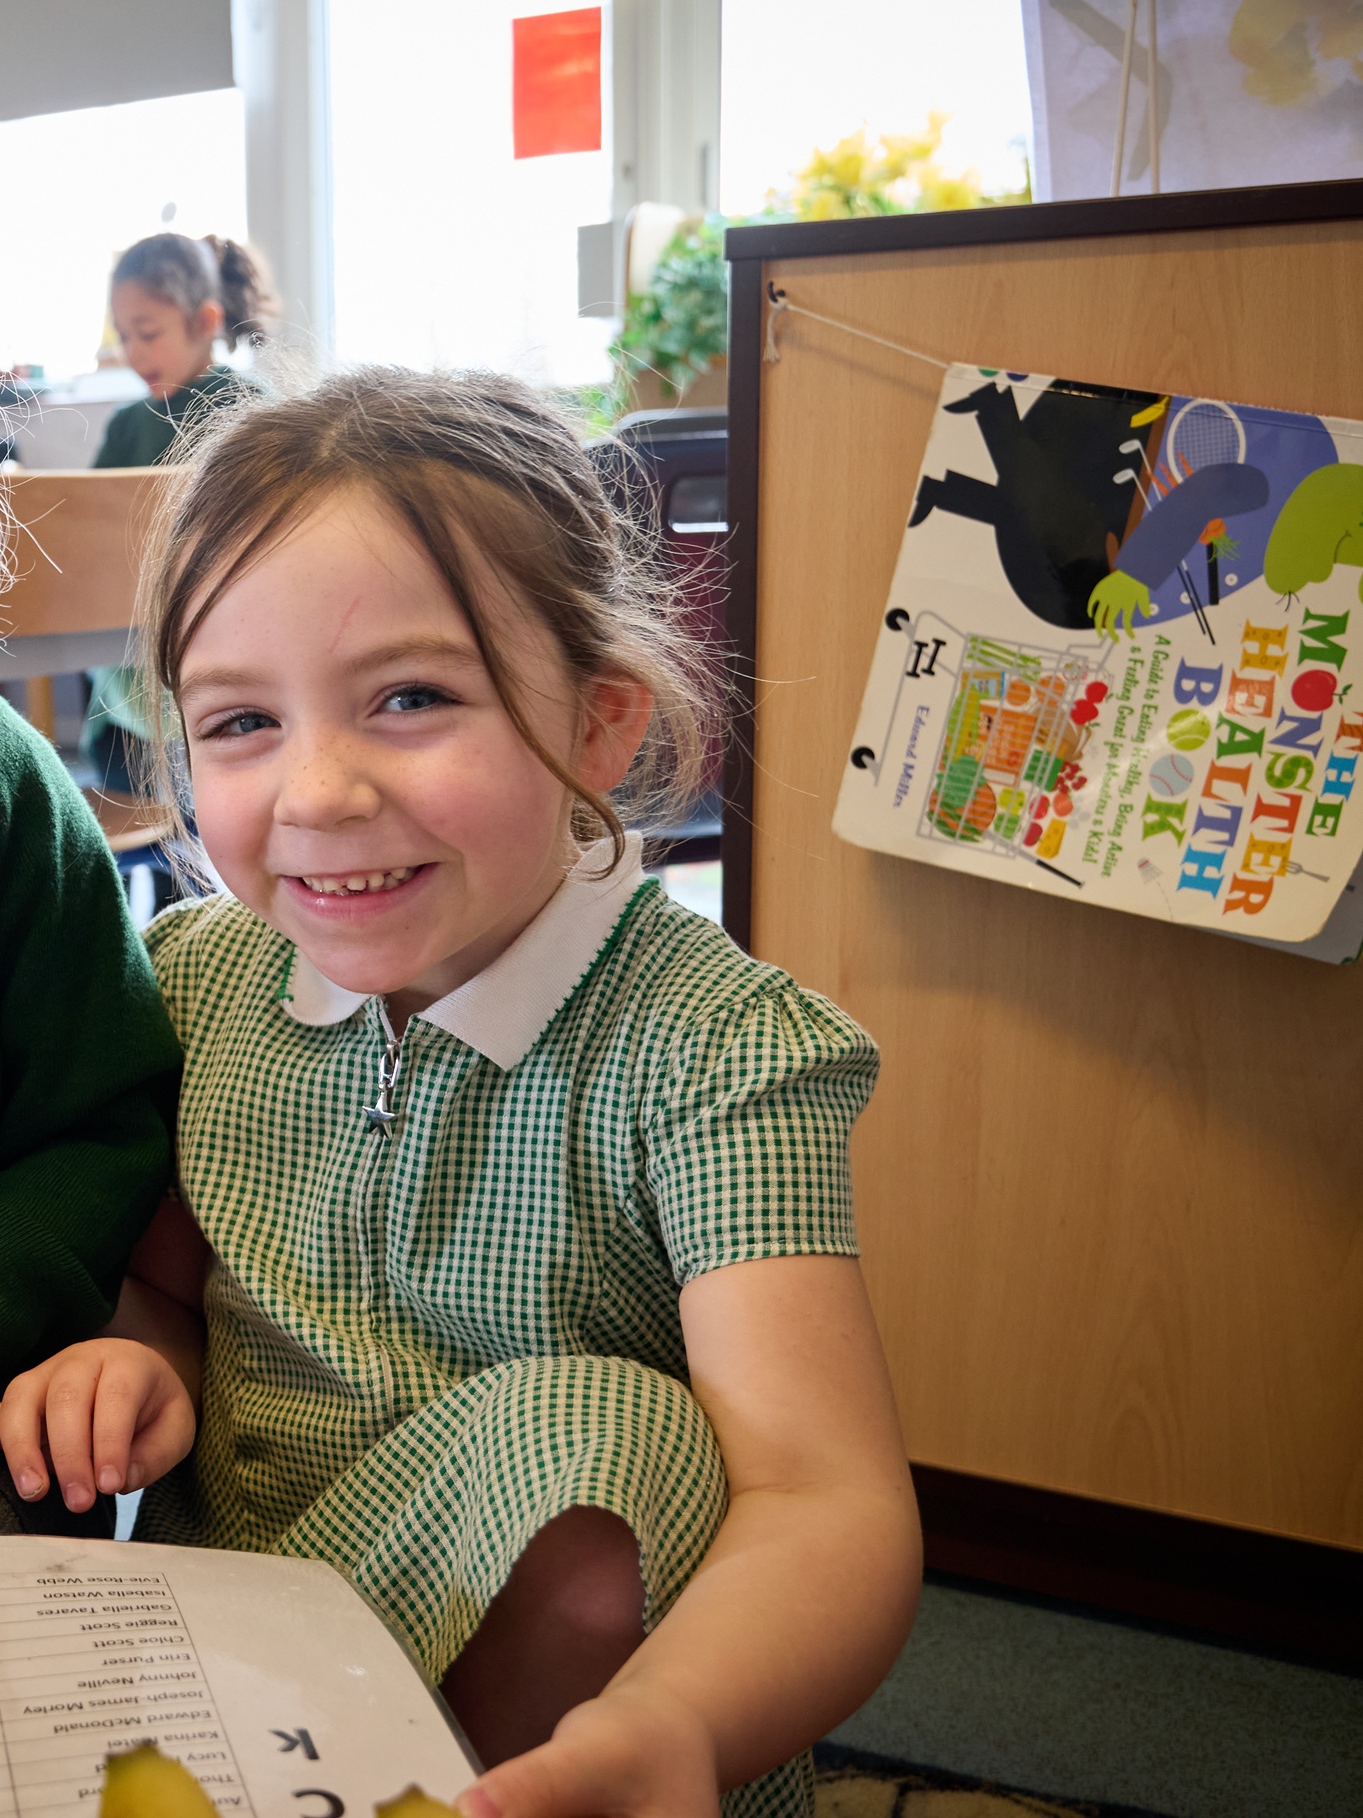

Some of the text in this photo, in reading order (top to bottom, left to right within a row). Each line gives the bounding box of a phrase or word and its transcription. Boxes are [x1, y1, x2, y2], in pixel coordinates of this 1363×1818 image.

[1155, 634, 1171, 646] A
[1147, 649, 1170, 687] Guide
[1116, 657, 1144, 702] Feeling
[1143, 687, 1160, 700] to
[1113, 705, 1134, 739] Great
[1131, 704, 1159, 744] Eating
[1104, 740, 1123, 758] for
[893, 704, 930, 809] Edward Miller
[1176, 618, 1289, 900] HEALTH
[1107, 803, 1134, 838] Being
[36, 1576, 160, 1585] Evie-Rose Webb
[43, 1589, 166, 1600] Isabella Watson
[36, 1603, 172, 1617] Gabriella Tavares
[80, 1618, 178, 1632] Reggie Scott
[92, 1635, 184, 1649] Chloe Scott
[101, 1652, 190, 1666] Erin Purser
[76, 1670, 197, 1689] Johnny Neville
[22, 1701, 83, 1715] Morley
[53, 1709, 211, 1735] Edward McDonald
[164, 1729, 219, 1743] Karina
[186, 1750, 227, 1763] Lucy
